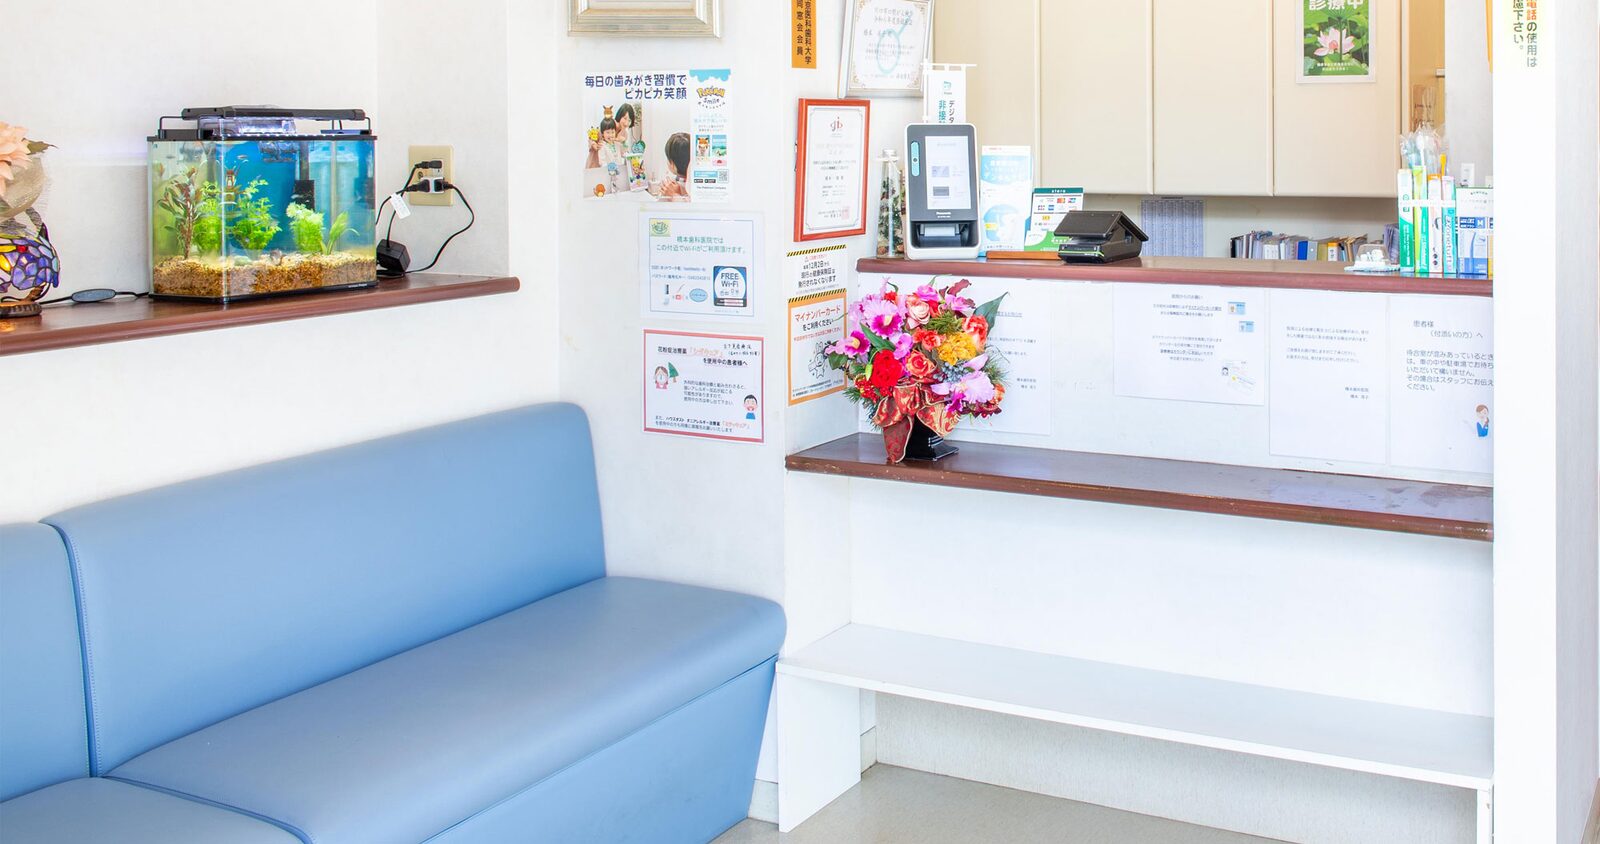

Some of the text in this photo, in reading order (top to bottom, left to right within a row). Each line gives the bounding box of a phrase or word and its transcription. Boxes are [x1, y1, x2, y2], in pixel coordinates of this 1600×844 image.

[584, 74, 687, 88] 毎日の歯みがき習慣で
[624, 87, 688, 100] ピカピカ笑顔
[794, 304, 841, 322] マイナンバーカード
